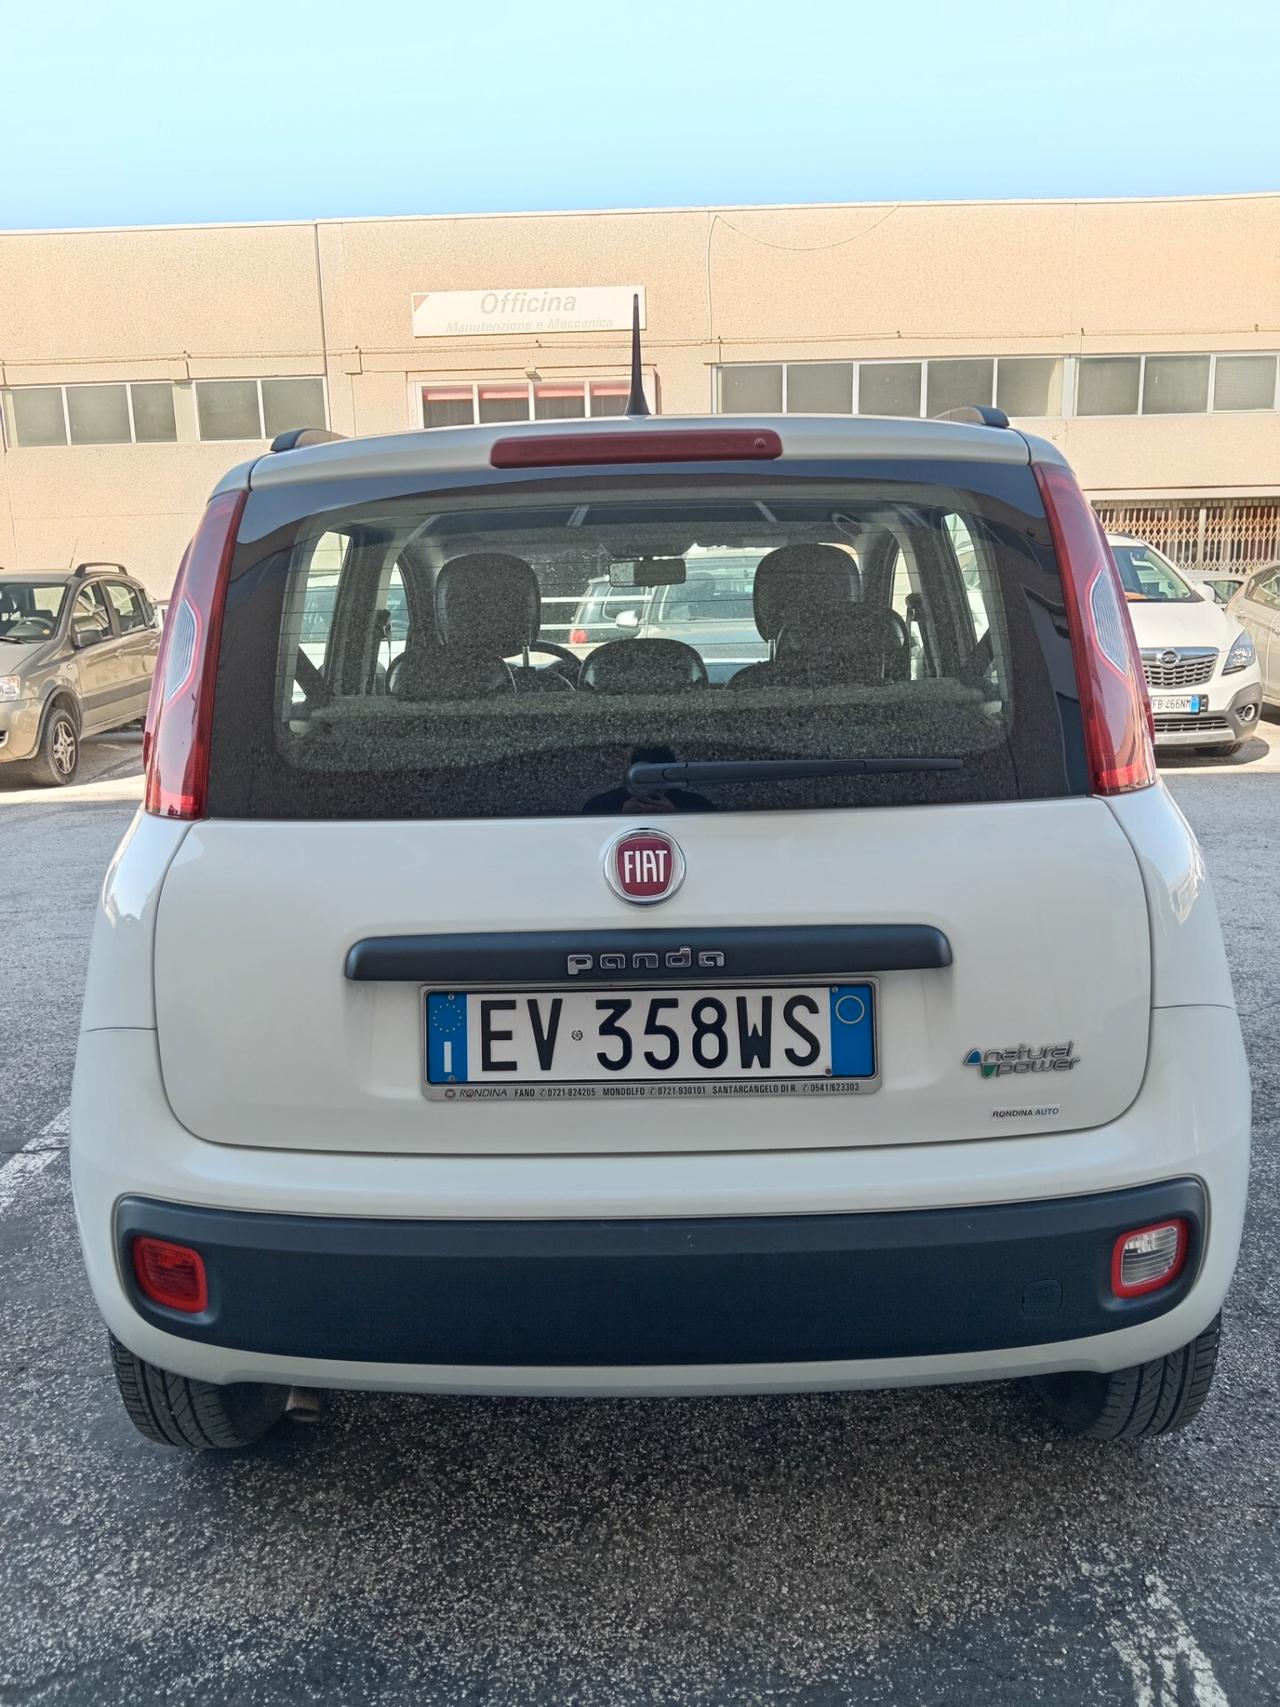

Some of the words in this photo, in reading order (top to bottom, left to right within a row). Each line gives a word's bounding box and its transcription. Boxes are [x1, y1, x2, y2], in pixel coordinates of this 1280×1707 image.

[480, 291, 577, 314] Officina
[446, 320, 532, 333] Manutenzione
[536, 321, 544, 329] e
[548, 318, 613, 329] Meccanica
[623, 850, 668, 883] FIAT
[567, 946, 725, 975] panda
[480, 998, 563, 1072] EV
[595, 994, 821, 1071] 358WS
[983, 1040, 1074, 1062] natural
[995, 1056, 1081, 1078] power
[459, 1088, 508, 1098] RONDINA
[514, 1088, 535, 1097] FANO
[602, 1086, 645, 1096] MONDOLFO
[712, 1084, 778, 1094] SANTARCANGELO
[992, 1109, 1033, 1118] RONDINA
[1034, 1107, 1059, 1116] AUTO
